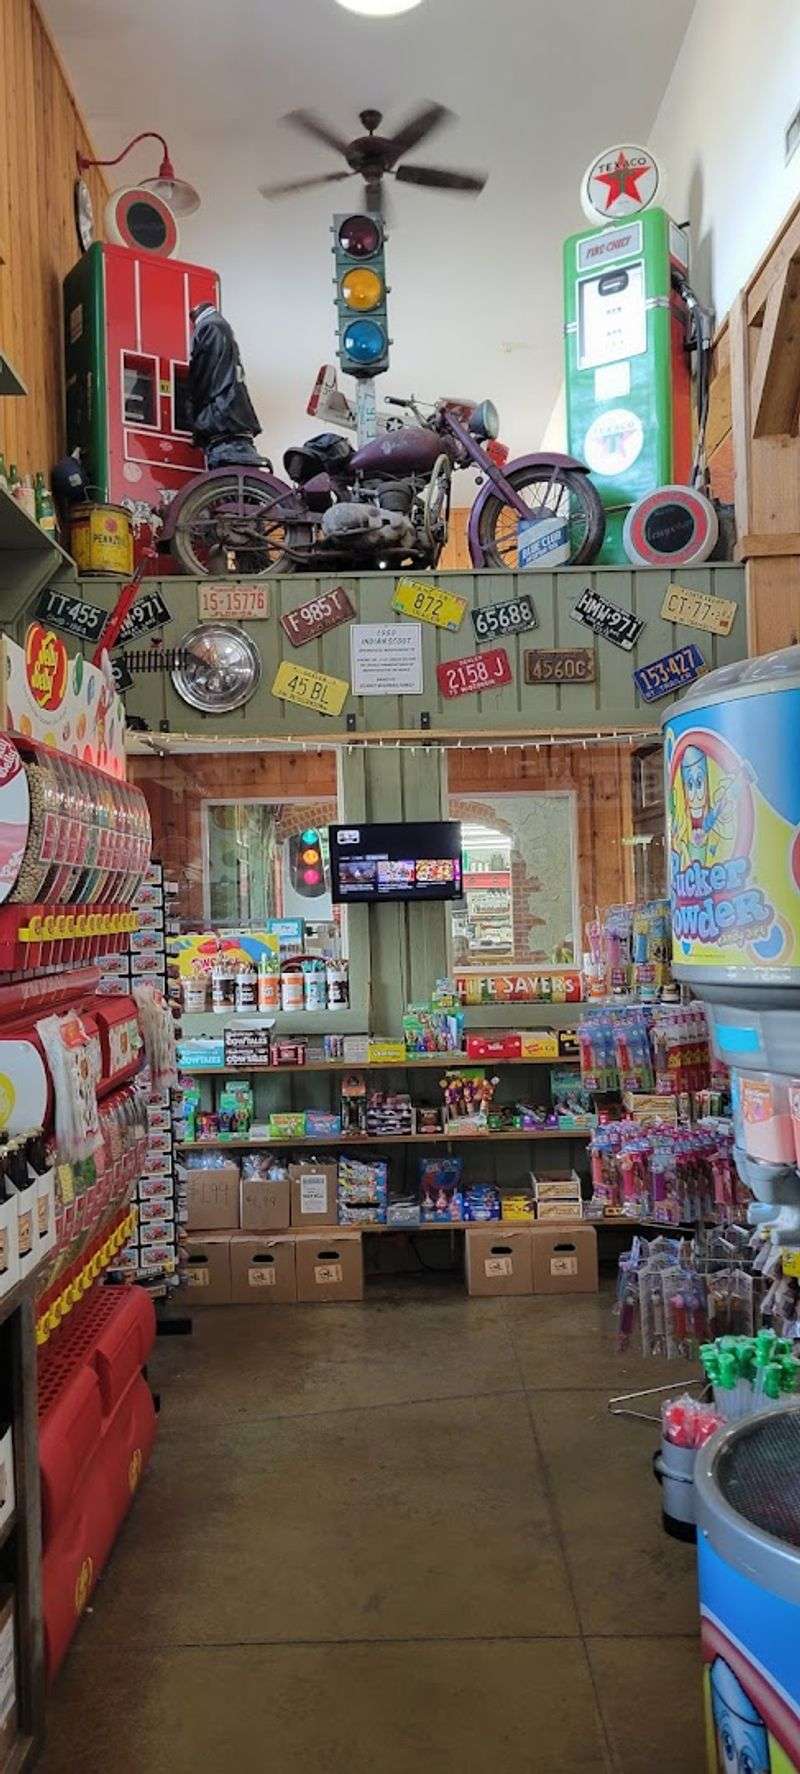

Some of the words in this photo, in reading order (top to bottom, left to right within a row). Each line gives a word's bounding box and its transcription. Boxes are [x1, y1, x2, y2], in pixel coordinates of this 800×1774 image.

[599, 157, 647, 172] TEXACO
[413, 592, 444, 616] 872
[476, 602, 532, 634] 65688
[447, 662, 489, 690] 2158
[494, 656, 504, 677] J
[287, 675, 308, 695] 45
[310, 681, 329, 704] BL
[458, 975, 497, 995] LIFE
[502, 974, 575, 994] SAVERS
